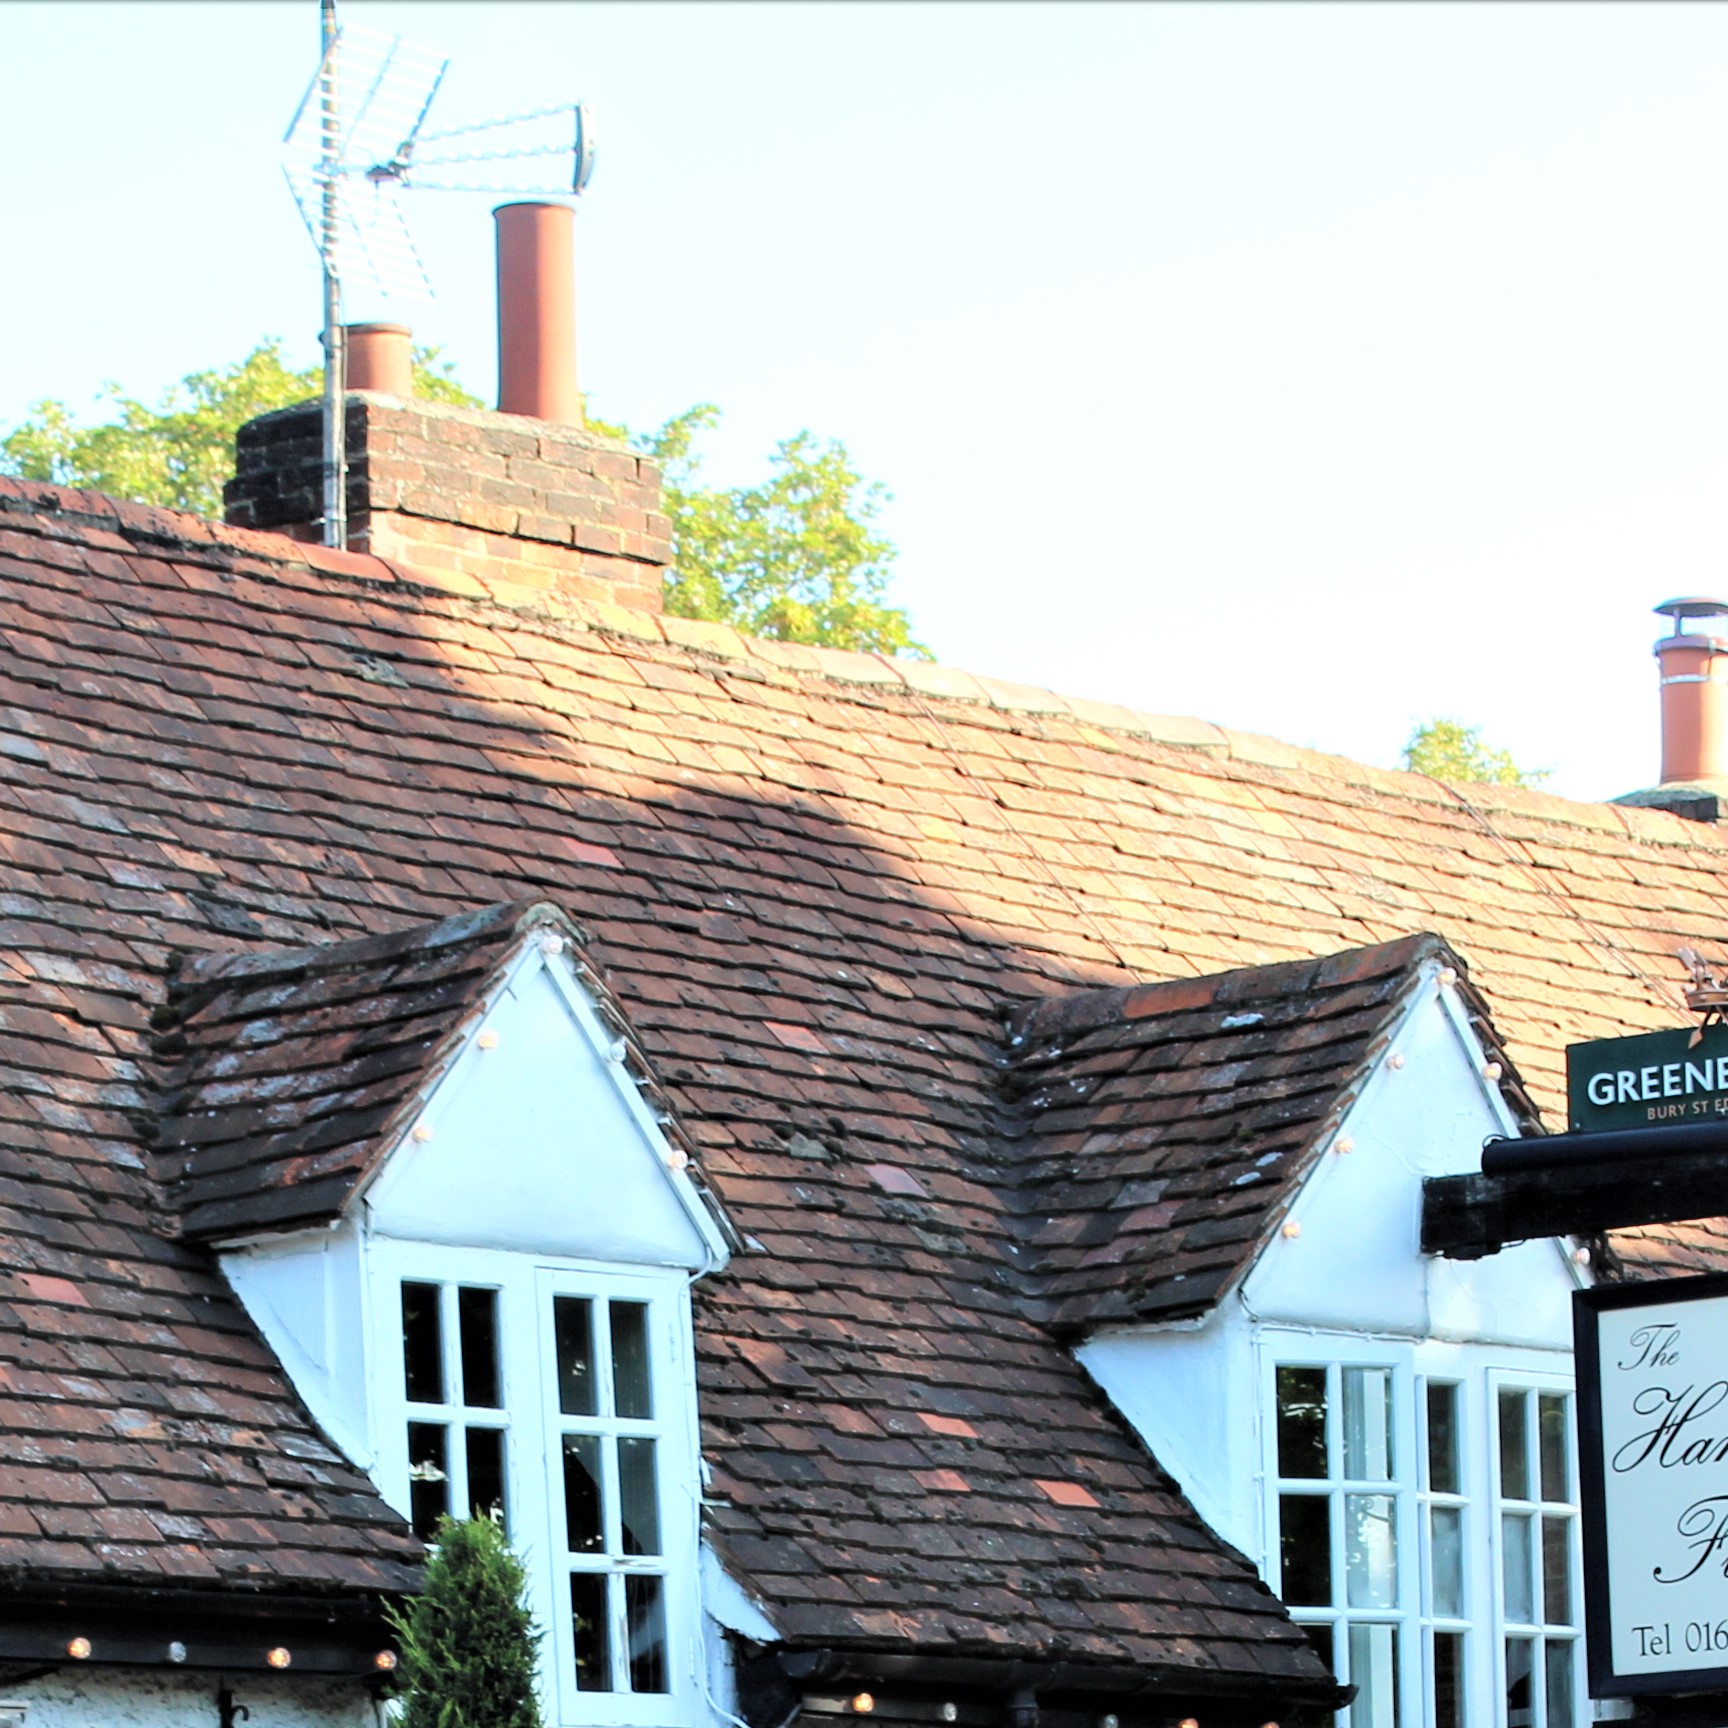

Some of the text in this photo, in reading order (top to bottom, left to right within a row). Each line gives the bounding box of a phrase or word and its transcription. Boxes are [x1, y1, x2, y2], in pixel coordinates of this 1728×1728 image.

[1646, 1104, 1686, 1121] BURY
[1692, 1101, 1709, 1114] ST
[1617, 1323, 1681, 1371] The
[1632, 1623, 1672, 1656] Tel
